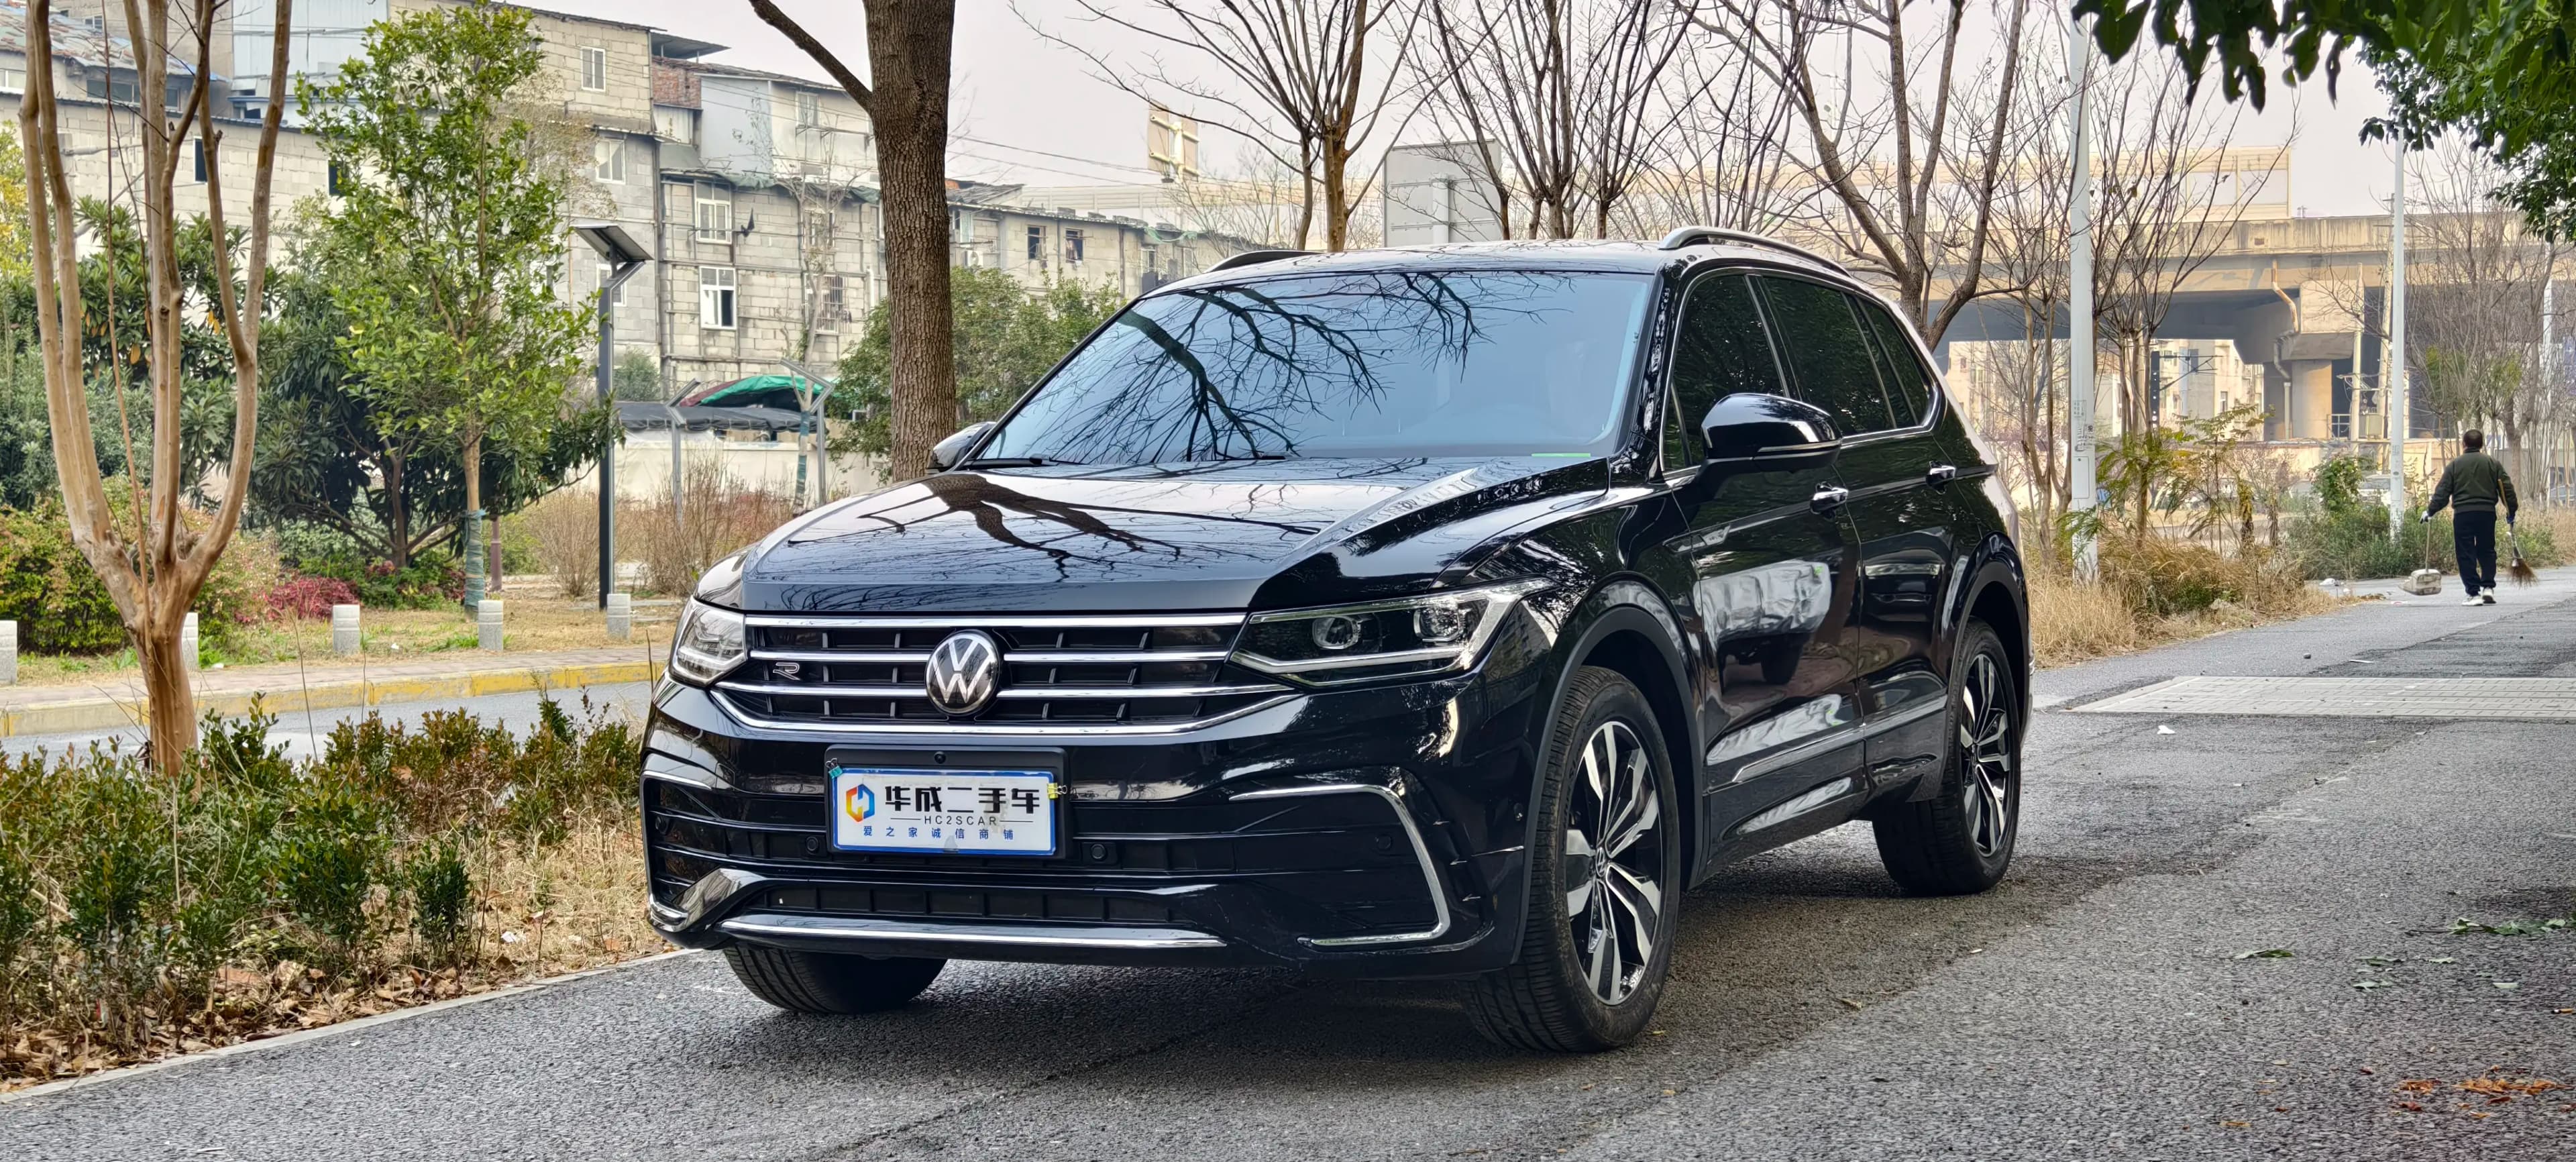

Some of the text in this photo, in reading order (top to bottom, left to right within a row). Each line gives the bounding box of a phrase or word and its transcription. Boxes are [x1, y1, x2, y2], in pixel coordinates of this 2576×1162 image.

[772, 662, 800, 680] R
[926, 633, 997, 713] VW
[885, 786, 1040, 814] 华成二手车
[924, 815, 998, 826] HC2SCAR
[863, 826, 1014, 840] 爱之家诚信商铺
